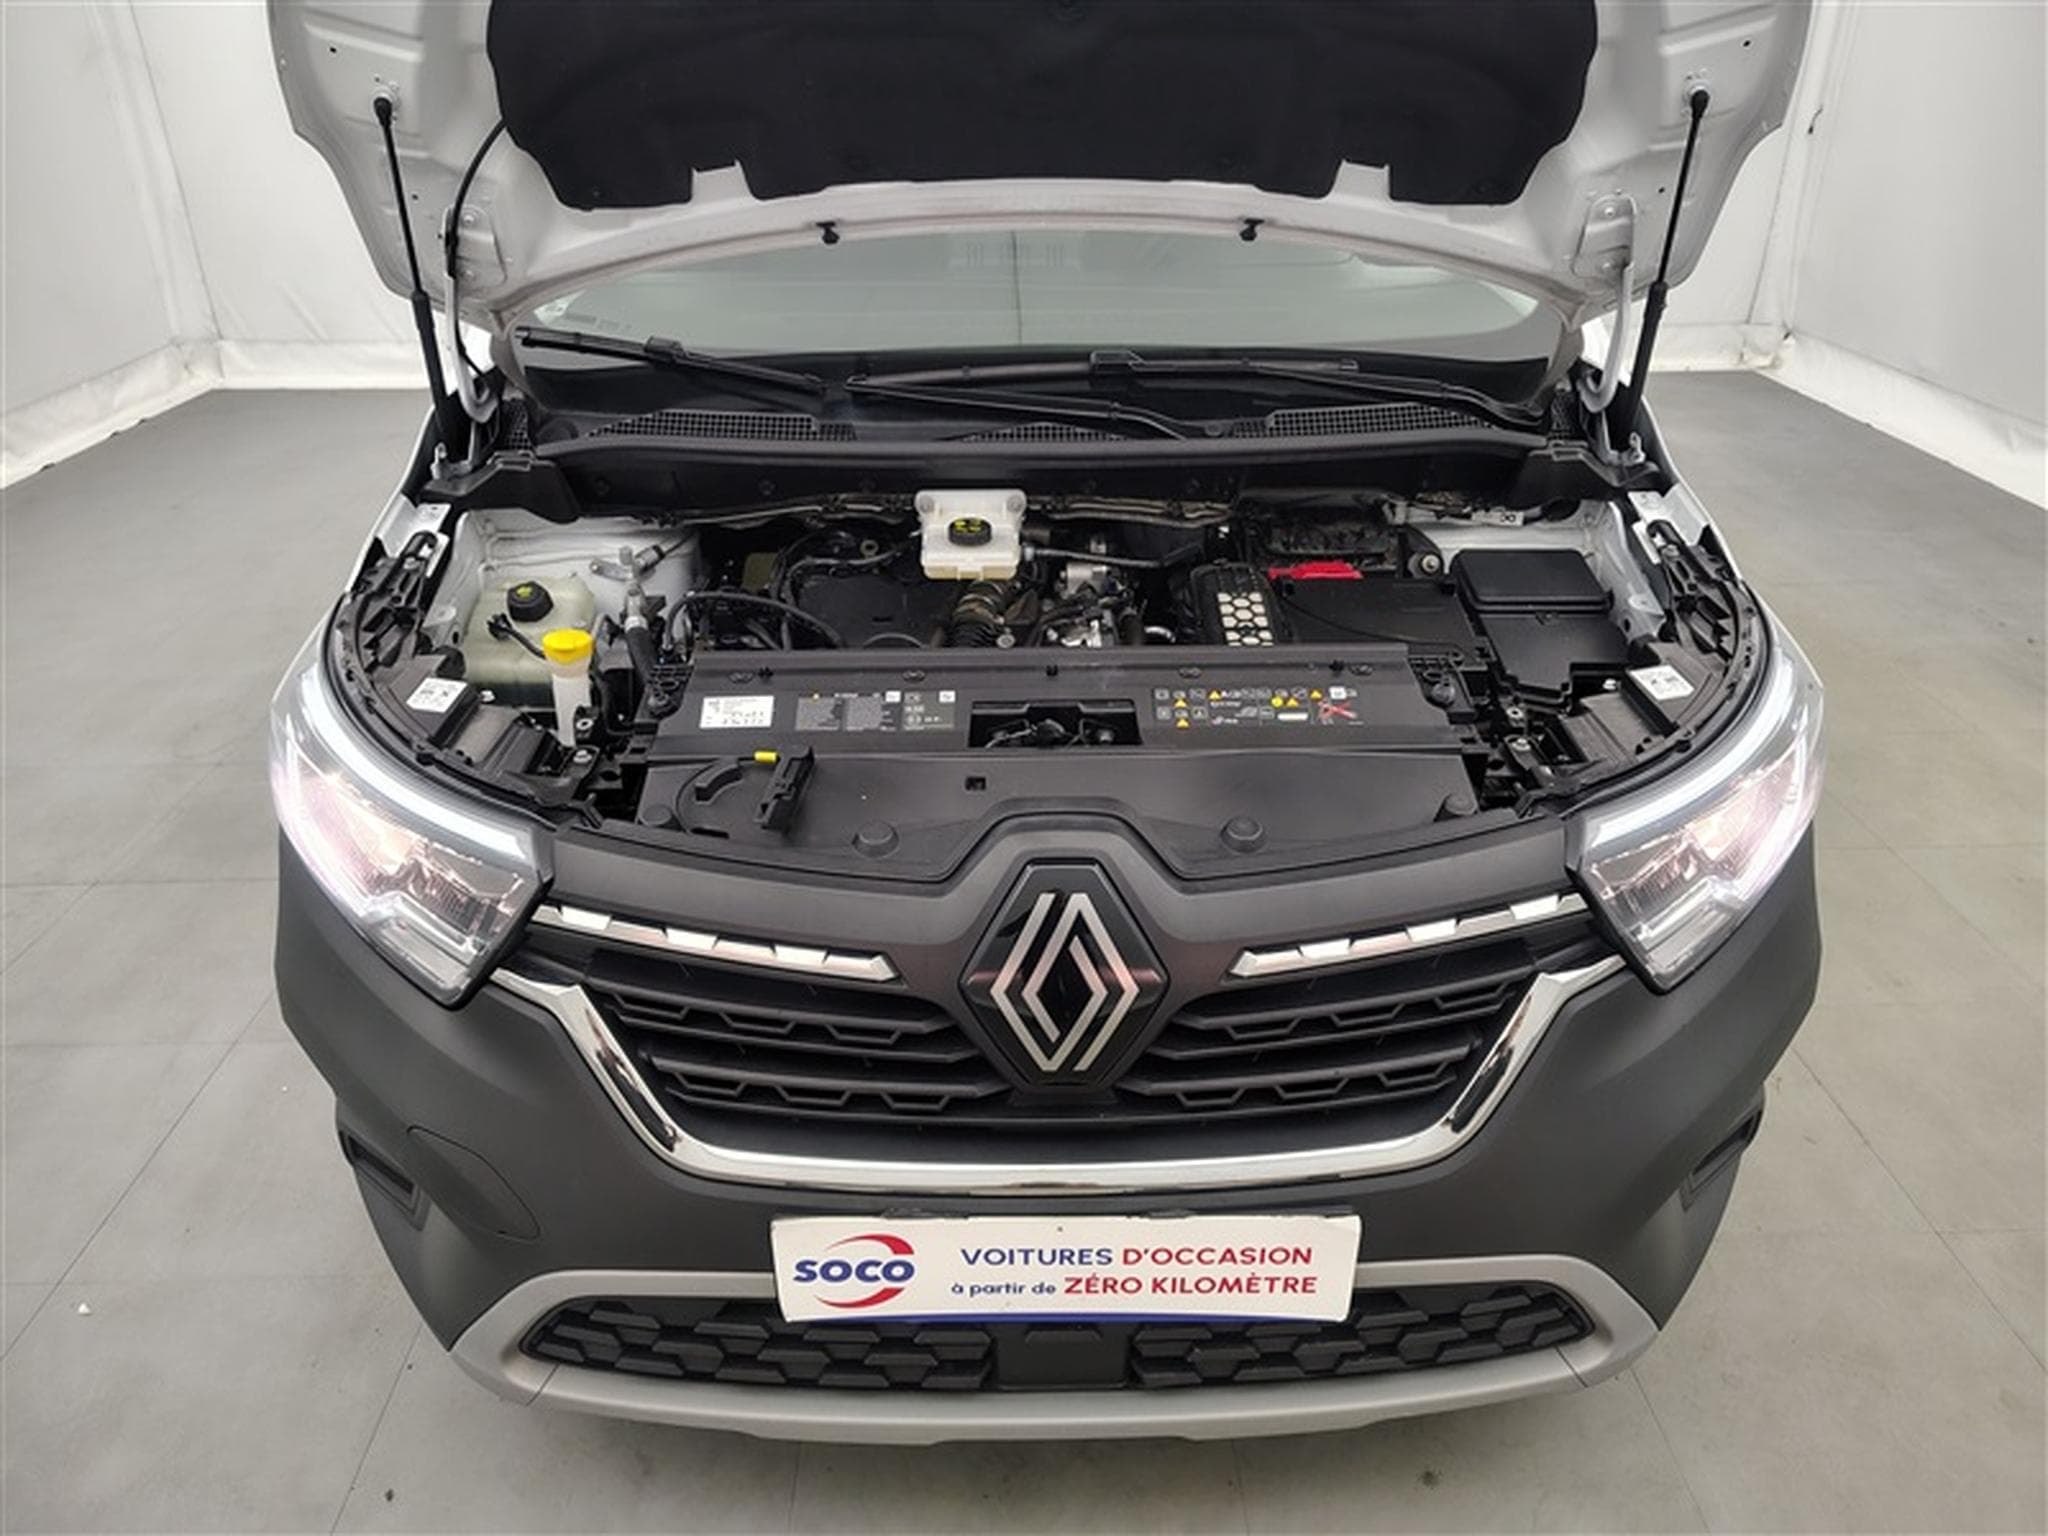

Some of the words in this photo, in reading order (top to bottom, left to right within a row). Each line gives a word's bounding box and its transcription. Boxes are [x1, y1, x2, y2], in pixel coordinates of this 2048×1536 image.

[960, 1247, 1113, 1266] VOITURES
[1122, 1246, 1313, 1266] D'OCCASION
[793, 1259, 916, 1283] SOCO
[951, 1281, 964, 1294] à
[969, 1281, 1026, 1298] partir
[1031, 1281, 1056, 1294] de
[1064, 1272, 1143, 1295] ZÉRO
[1151, 1272, 1318, 1295] KILOMÈTRE
